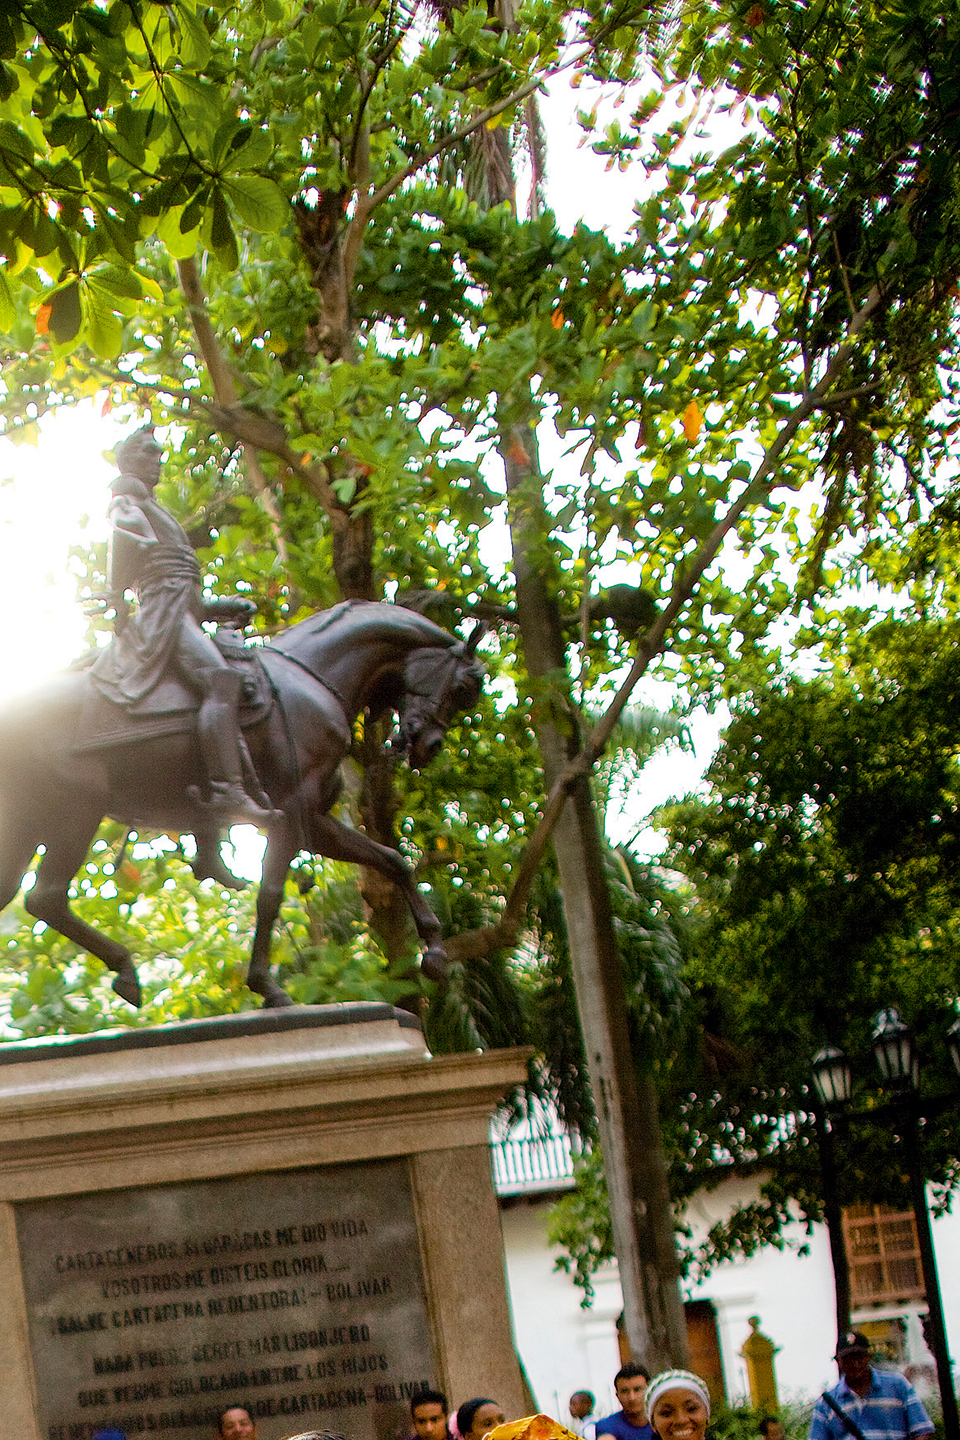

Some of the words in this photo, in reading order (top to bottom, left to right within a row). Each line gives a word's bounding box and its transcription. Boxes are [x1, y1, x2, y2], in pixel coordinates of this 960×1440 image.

[276, 1225, 297, 1246] ME
[331, 1219, 368, 1238] VIDA
[101, 1271, 181, 1299] VOSOTROS
[185, 1269, 206, 1289] ME
[326, 1277, 393, 1302] BOLIVAR
[306, 1360, 336, 1380] LOS
[341, 1353, 388, 1375] HIJOS
